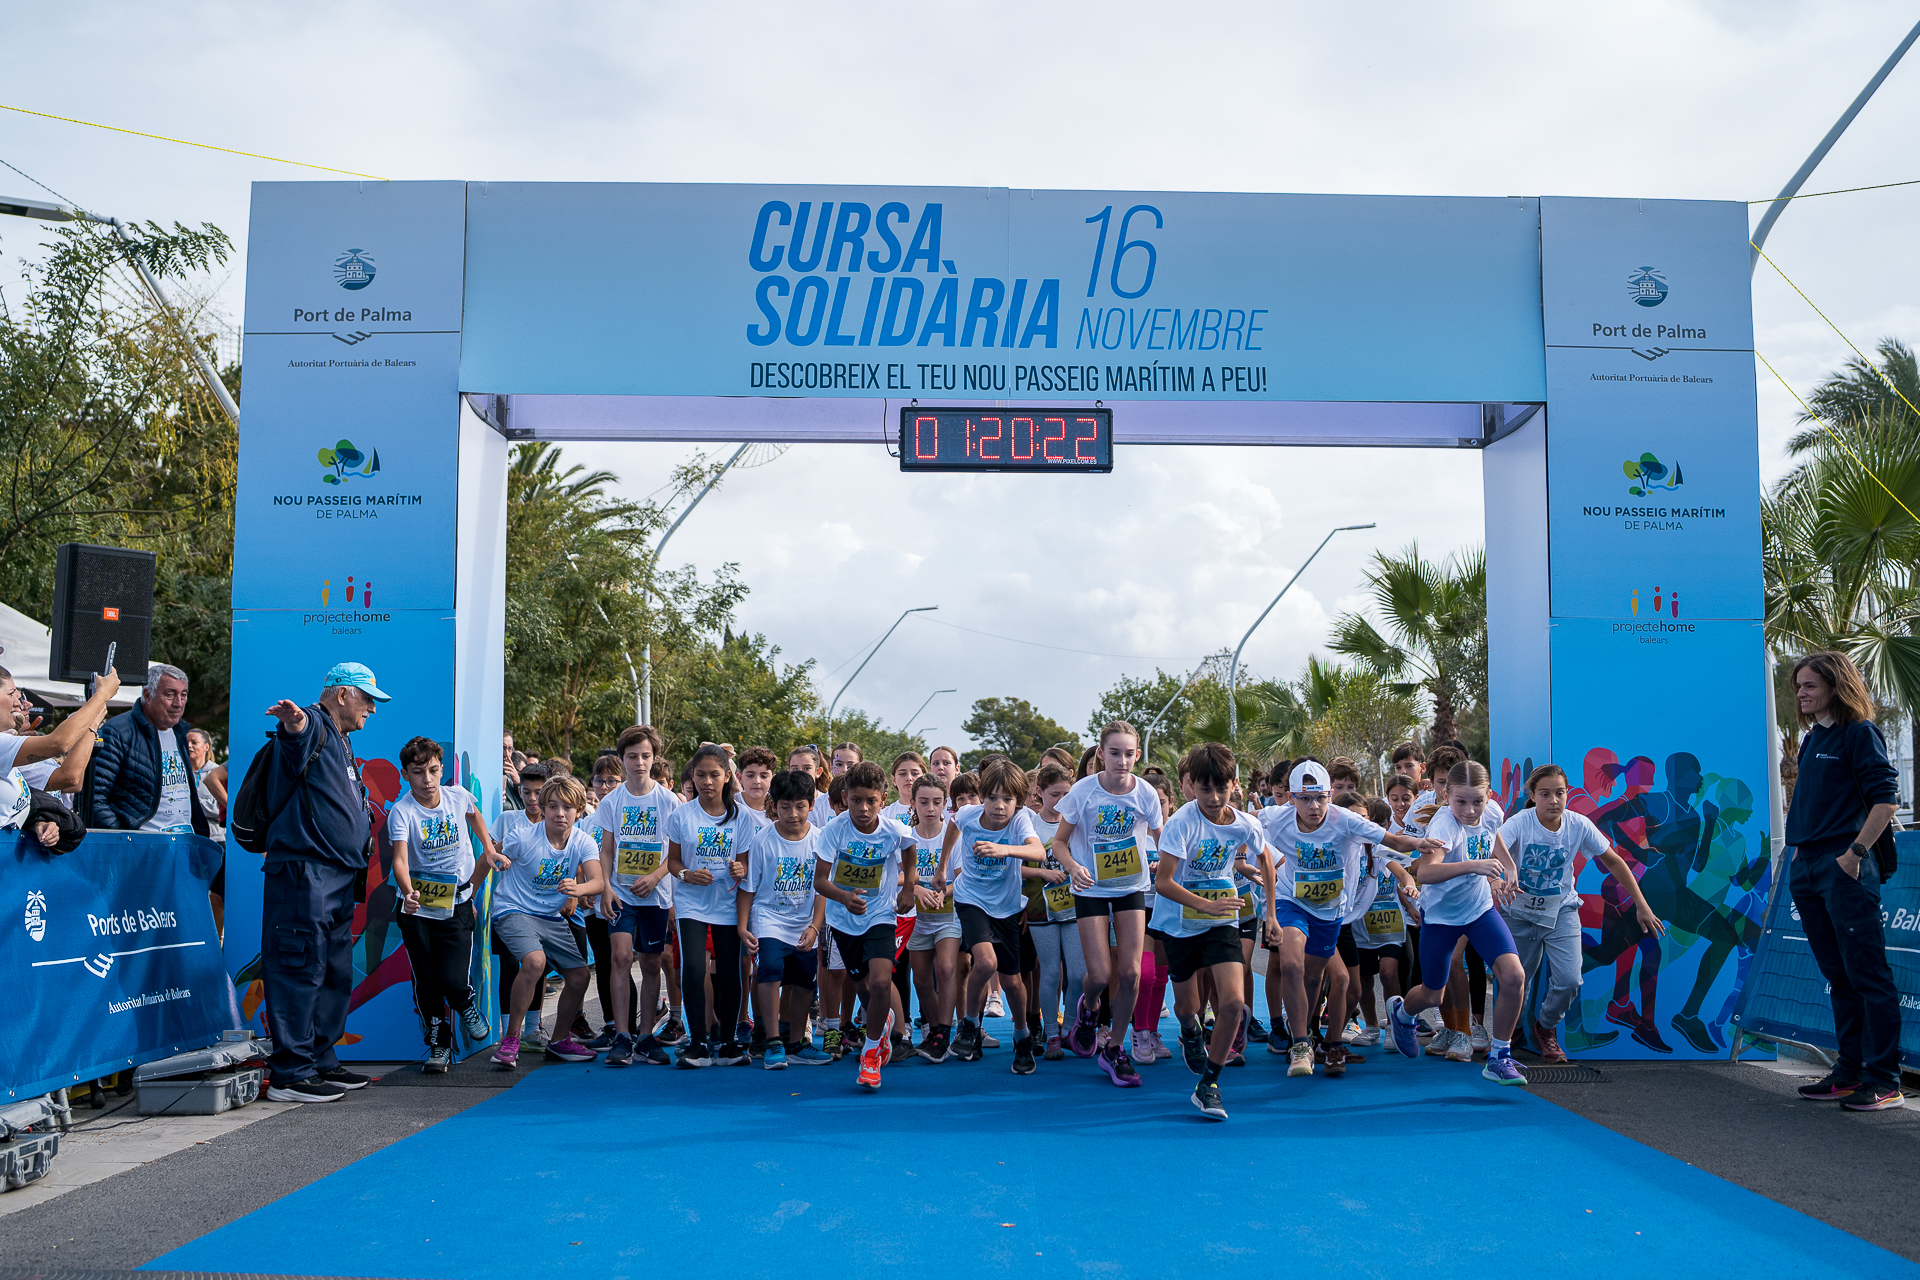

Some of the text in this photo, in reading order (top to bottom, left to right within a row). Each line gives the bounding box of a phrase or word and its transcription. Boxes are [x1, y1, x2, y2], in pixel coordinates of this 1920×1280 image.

[749, 200, 942, 273] CURSA
[1085, 204, 1163, 299] 16
[746, 260, 1059, 349] SOLIDÀRIA
[294, 307, 411, 322] Port de Palma
[1076, 308, 1268, 351] NOVEMBRE
[1593, 323, 1706, 338] Port de Palma
[750, 360, 1267, 392] DESCOBREIX EL TEU NOU PASSEIG MARÍTIM A PEU!
[1629, 374, 1668, 382] Portuària
[274, 493, 421, 505] NOU PASSEIG MARÍTIM
[317, 510, 377, 518] DE PALMA
[1584, 505, 1725, 518] NOU PASSEIG MARÍTIM
[1625, 521, 1683, 530] DE PALMA
[304, 611, 390, 627] projectehome
[1612, 621, 1695, 636] projectehome
[1640, 636, 1668, 644] balears
[625, 852, 654, 865] 2418
[1104, 850, 1133, 868] 2441
[843, 865, 876, 879] 2434
[415, 882, 447, 897] 2442
[1303, 883, 1336, 898] 2429
[1530, 897, 1544, 906] 19
[87, 907, 176, 936] Ports de Balears
[1369, 911, 1396, 925] 2407
[108, 996, 142, 1014] Autoritat
